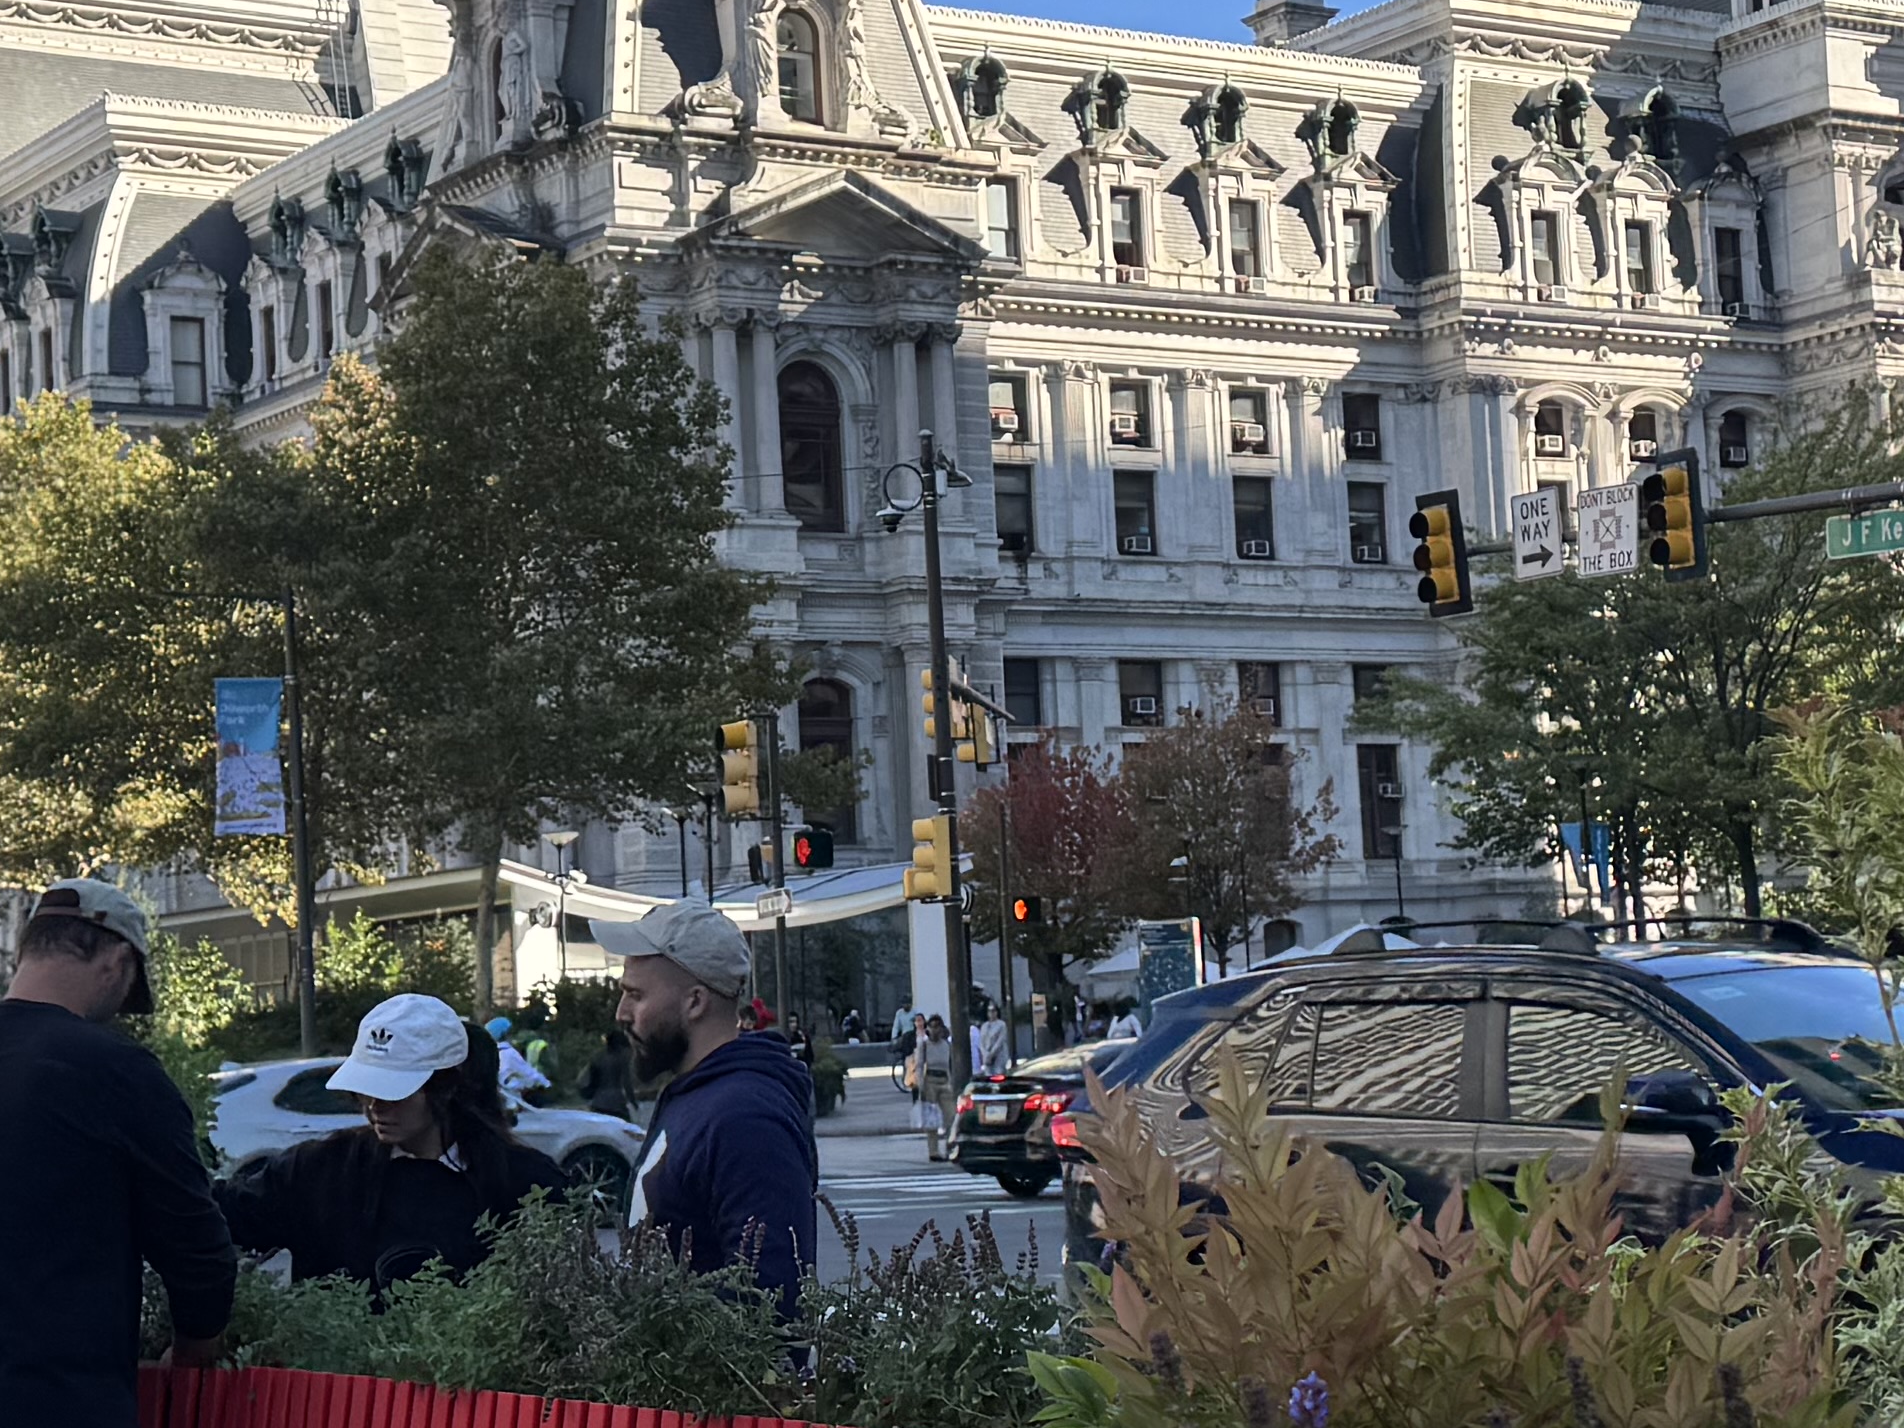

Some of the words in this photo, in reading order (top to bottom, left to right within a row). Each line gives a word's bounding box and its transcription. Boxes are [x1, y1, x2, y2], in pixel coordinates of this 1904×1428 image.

[1606, 487, 1634, 505] BLOCK
[1520, 497, 1549, 520] ONE
[1520, 519, 1550, 543] WAY
[1842, 523, 1852, 546] J
[1861, 521, 1871, 545] F
[1583, 554, 1604, 572] THE
[1609, 550, 1633, 569] BOX
